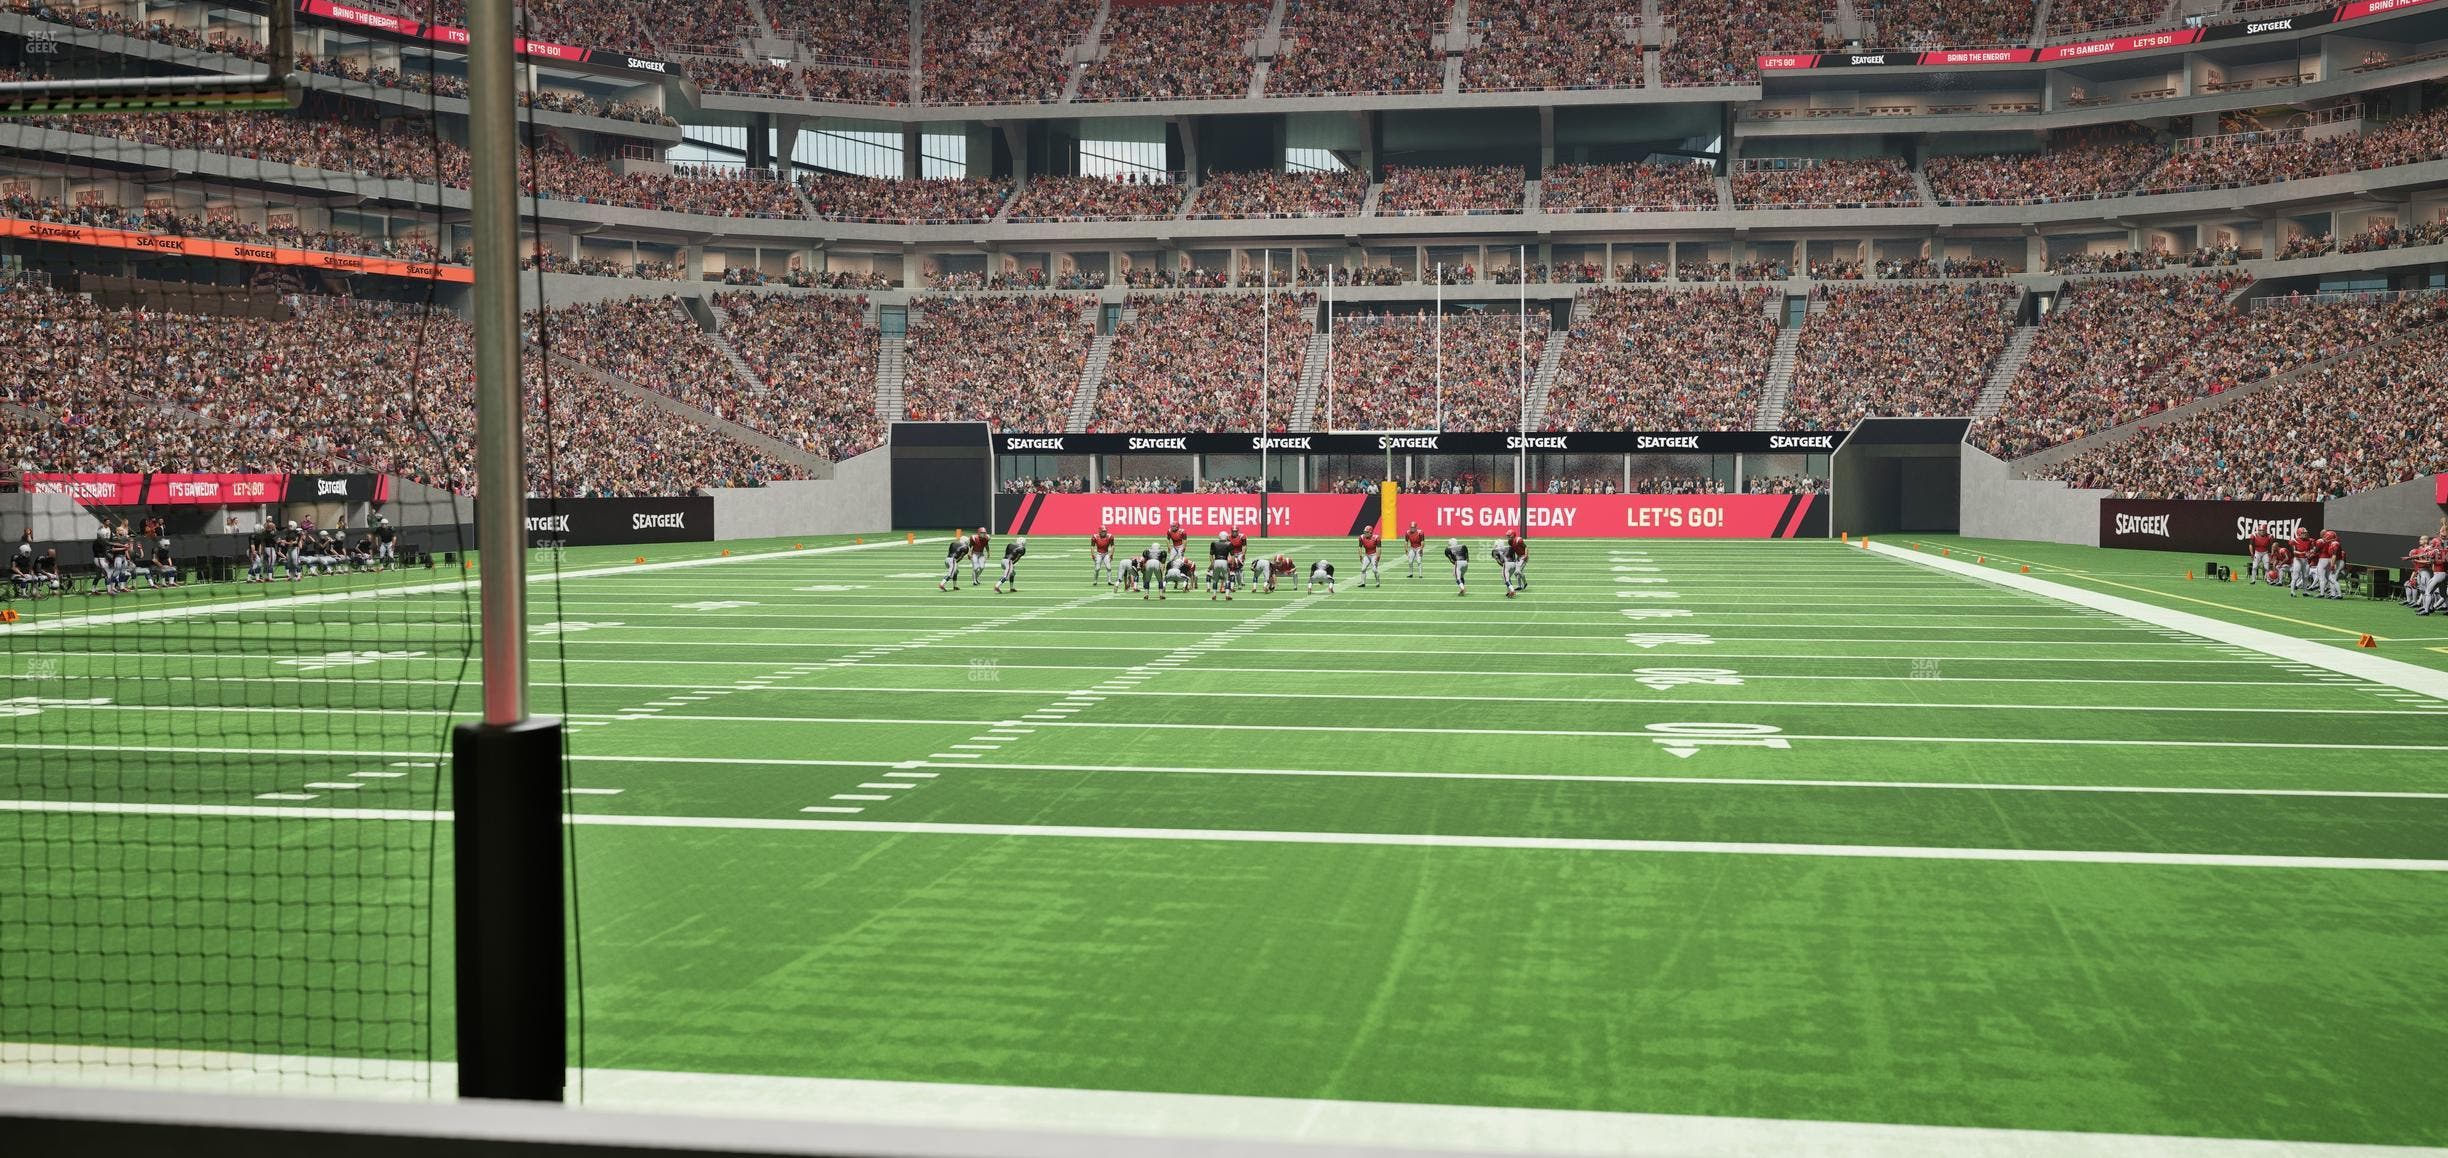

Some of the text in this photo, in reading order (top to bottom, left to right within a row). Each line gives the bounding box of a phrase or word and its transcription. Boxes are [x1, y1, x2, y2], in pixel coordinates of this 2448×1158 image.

[2369, 0, 2393, 12] BRING
[355, 11, 369, 23] THE
[2247, 18, 2292, 34] SEATGEEK
[448, 31, 465, 42] IT'S
[2133, 35, 2172, 48] LET'S GO!
[527, 43, 561, 57] ET'S GO!
[1947, 54, 1968, 62] BRING
[1982, 52, 2011, 61] ENERGY!
[2060, 43, 2115, 57] IT'S GAMEDAY
[627, 57, 666, 73] SEATGEEK
[1765, 59, 1796, 67] LET'S GO!
[1851, 55, 1885, 65] SEATGEEK
[136, 236, 184, 251] SEATGEEK
[1007, 437, 1064, 450] SEATGEEK
[1128, 437, 1187, 450] SEATGEEK
[1378, 436, 1439, 450] SEATGEEK
[1506, 436, 1568, 450] SEATGEEK
[1637, 435, 1699, 449] SEATGEEK
[1769, 435, 1833, 449] SEATGEEK
[184, 482, 220, 497] GAMEDAY
[525, 514, 570, 532] ATGEEK
[632, 512, 685, 530] SEATGEEK
[1101, 506, 1290, 526] BRING THE ENERGY!
[1437, 507, 1577, 526] IT'S GAMEDAY
[1627, 507, 1724, 527] LET'S GO!
[2115, 512, 2170, 537] SEATGEEK
